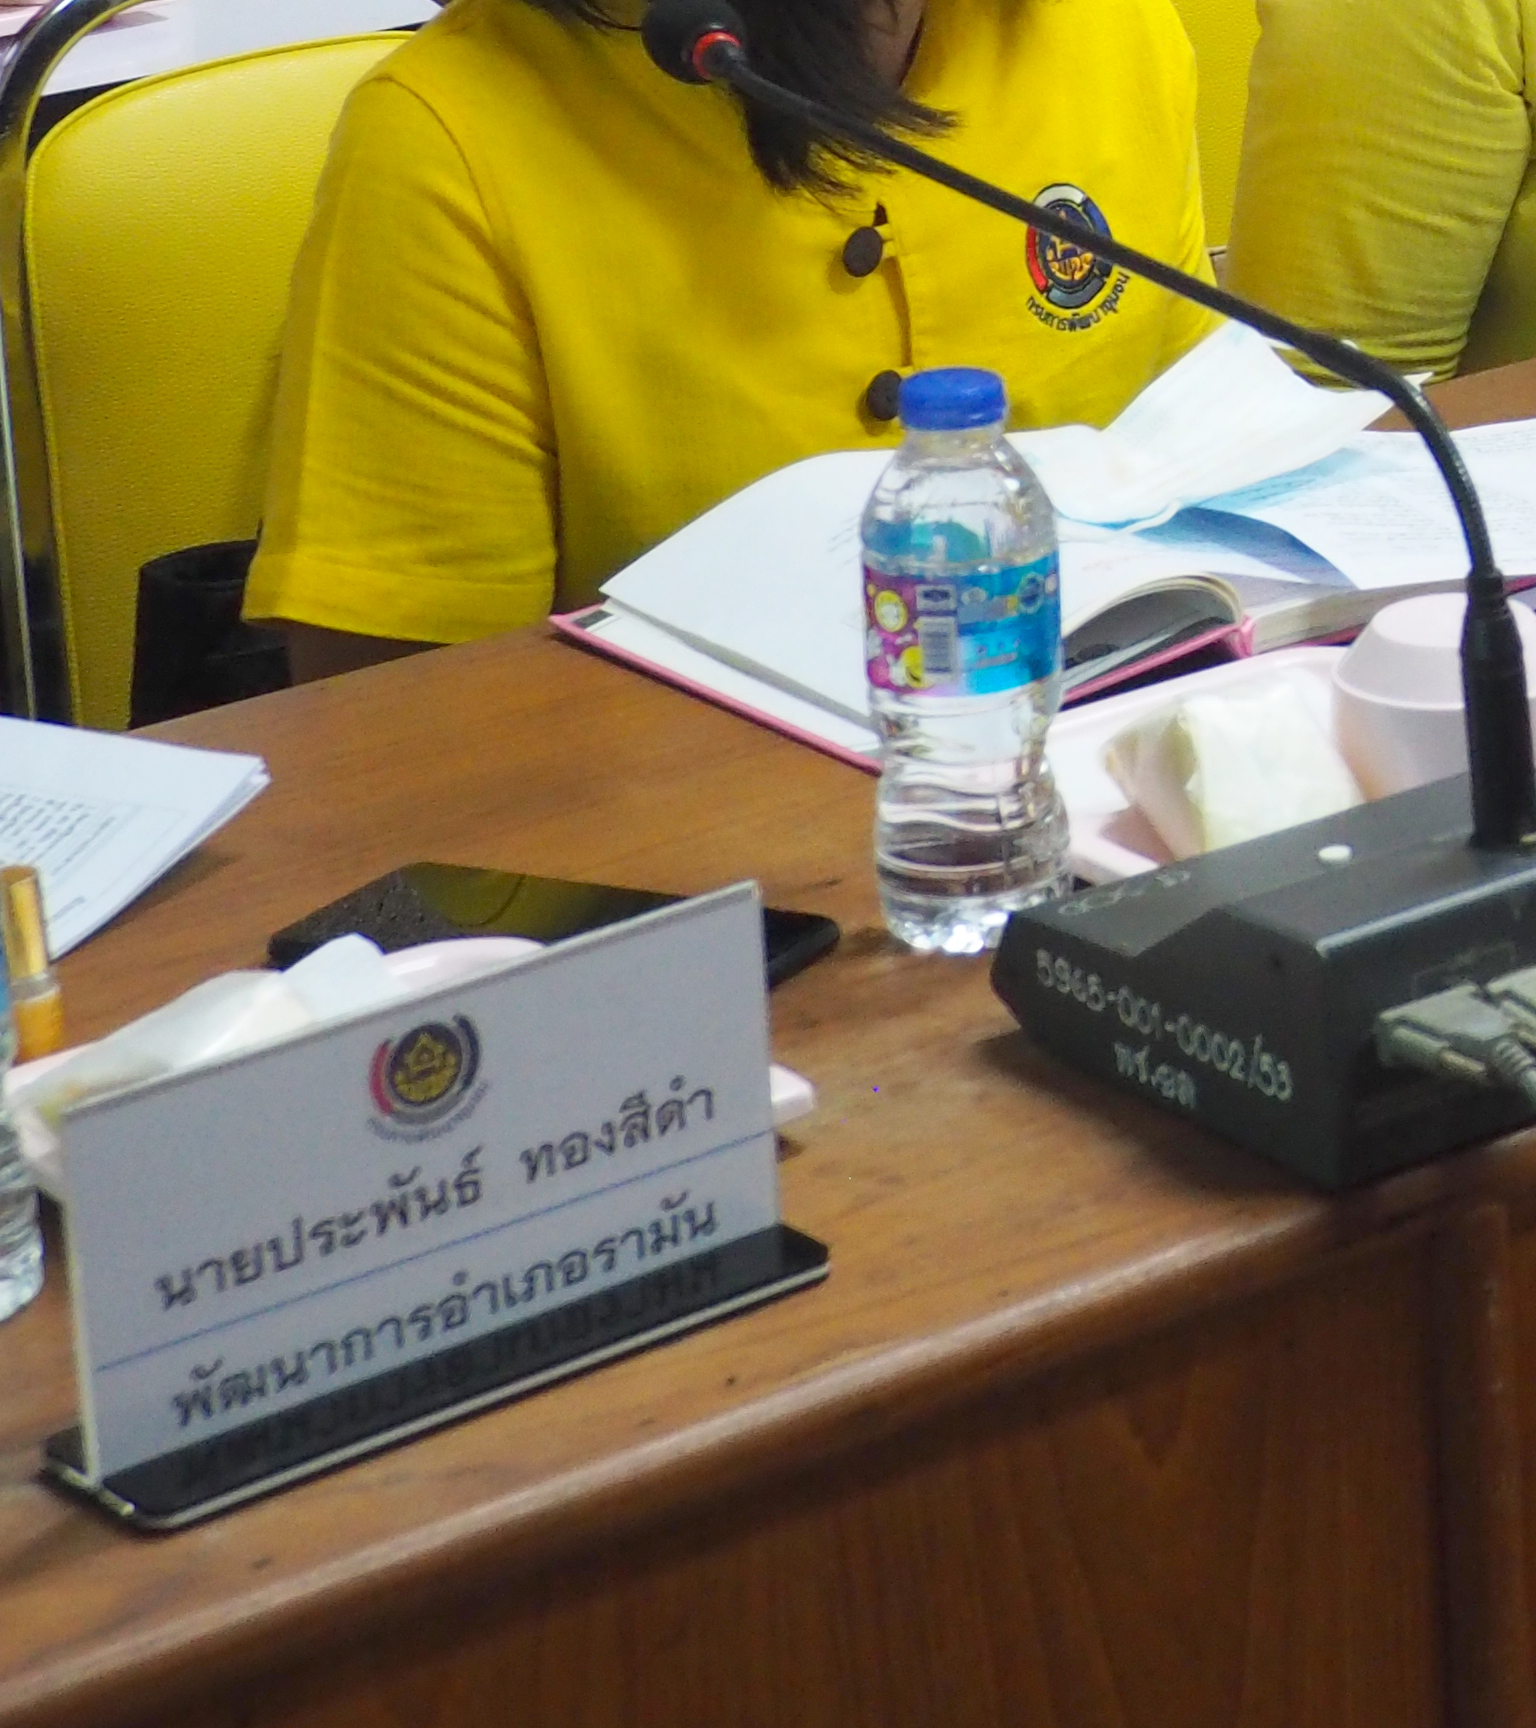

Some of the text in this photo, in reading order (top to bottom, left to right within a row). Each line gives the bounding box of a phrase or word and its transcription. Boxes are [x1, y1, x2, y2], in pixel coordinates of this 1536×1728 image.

[154, 1146, 486, 1314] นายประพันธ์
[518, 1080, 717, 1183] ทองสีดำ
[170, 1193, 720, 1428] พัฒนาการอำเภอรามัน
